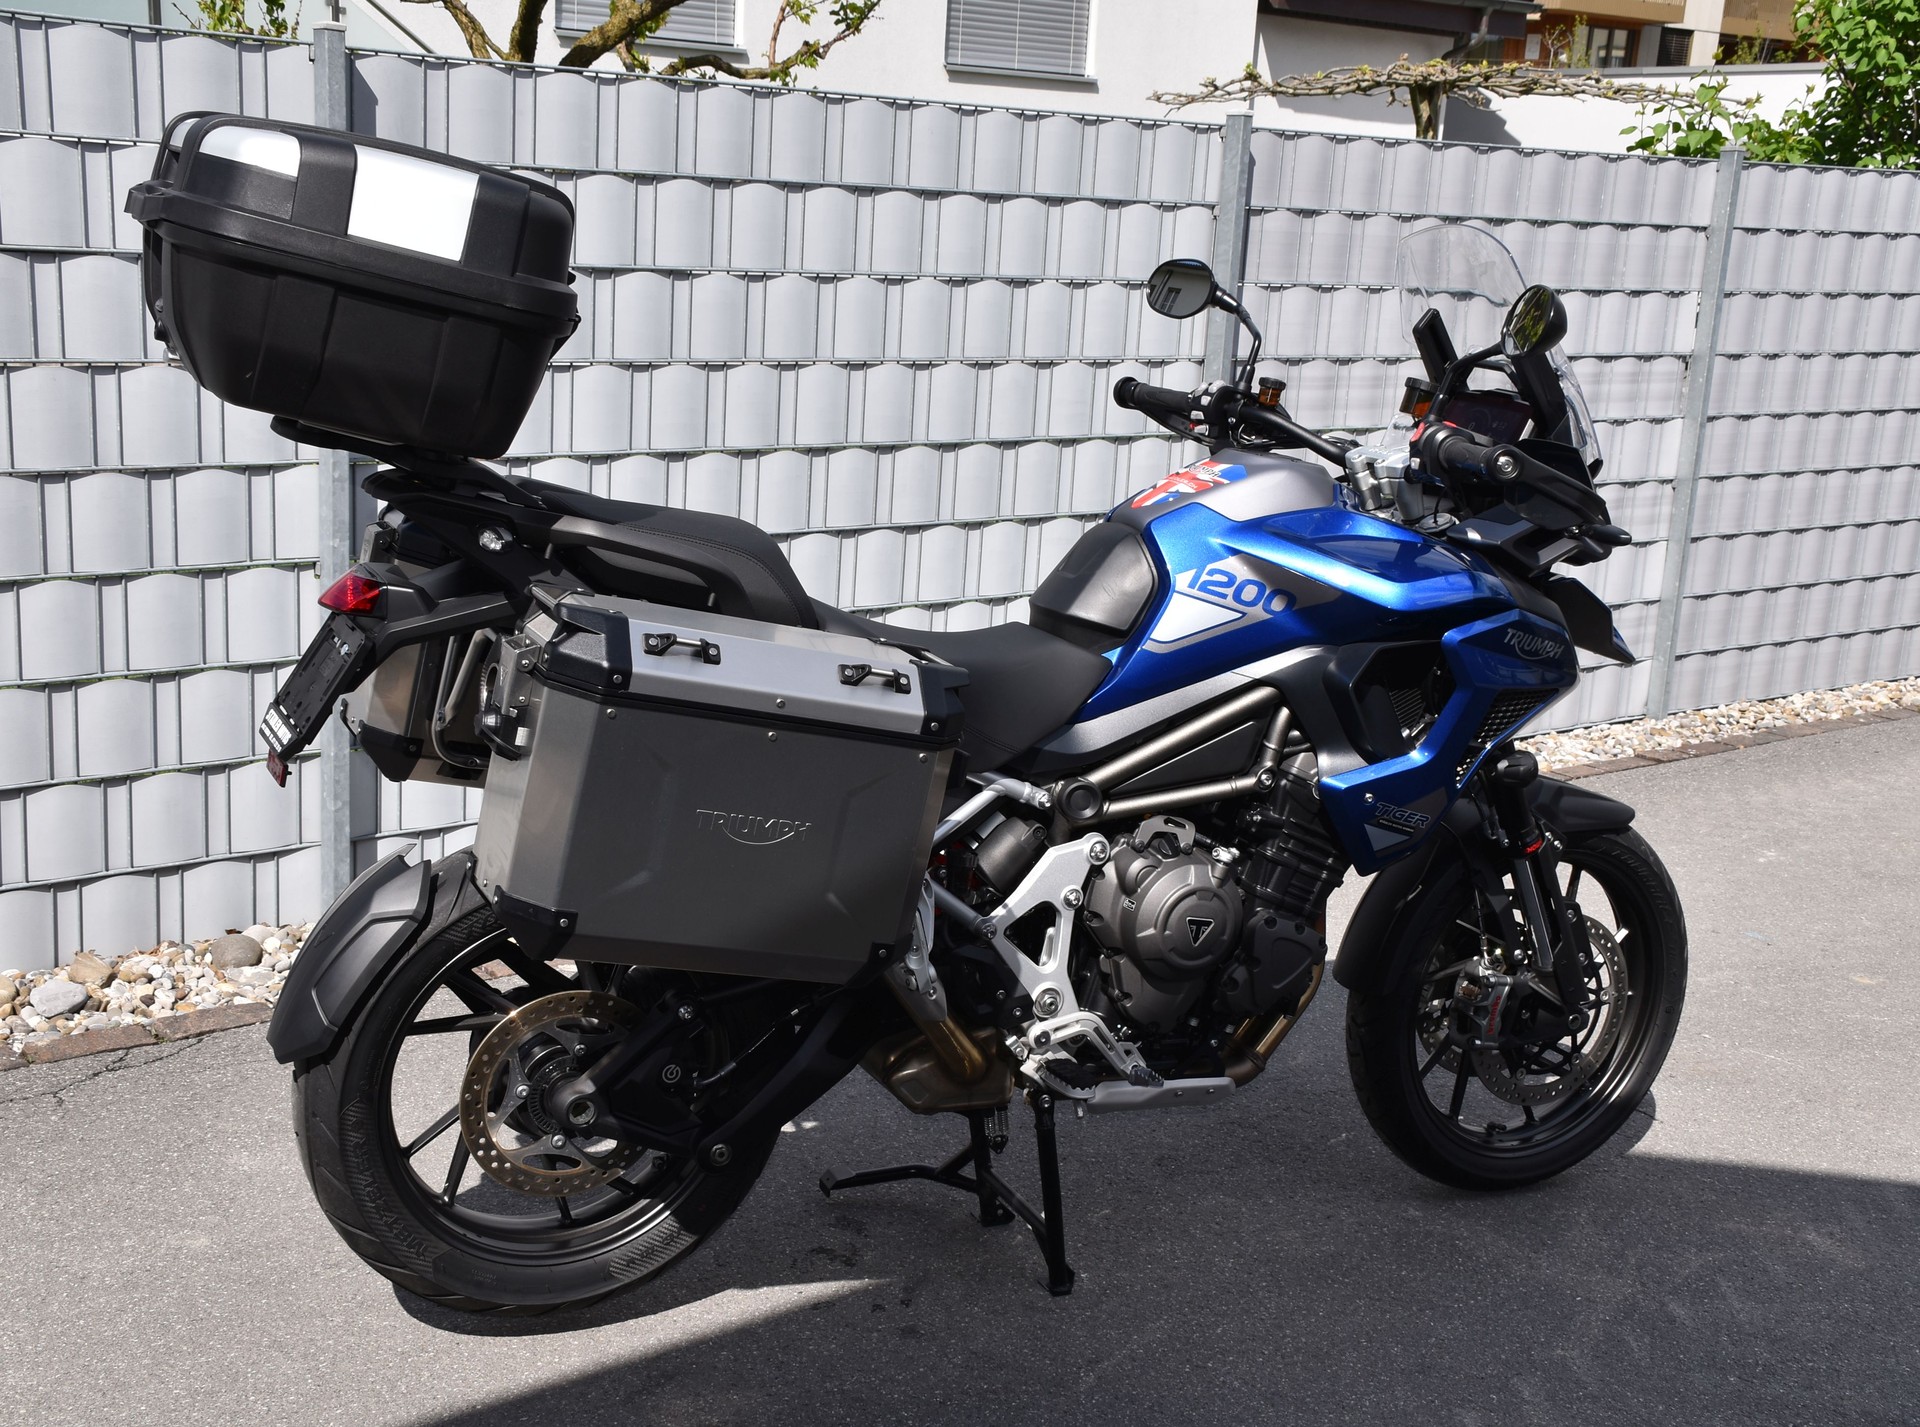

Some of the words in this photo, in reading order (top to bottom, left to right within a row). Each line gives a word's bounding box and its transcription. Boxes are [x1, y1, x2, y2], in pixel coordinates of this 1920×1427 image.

[1187, 567, 1297, 616] 1200
[1503, 628, 1565, 660] TRIUMPH
[696, 809, 812, 845] TRIUMPH
[1375, 801, 1431, 828] TIGER
